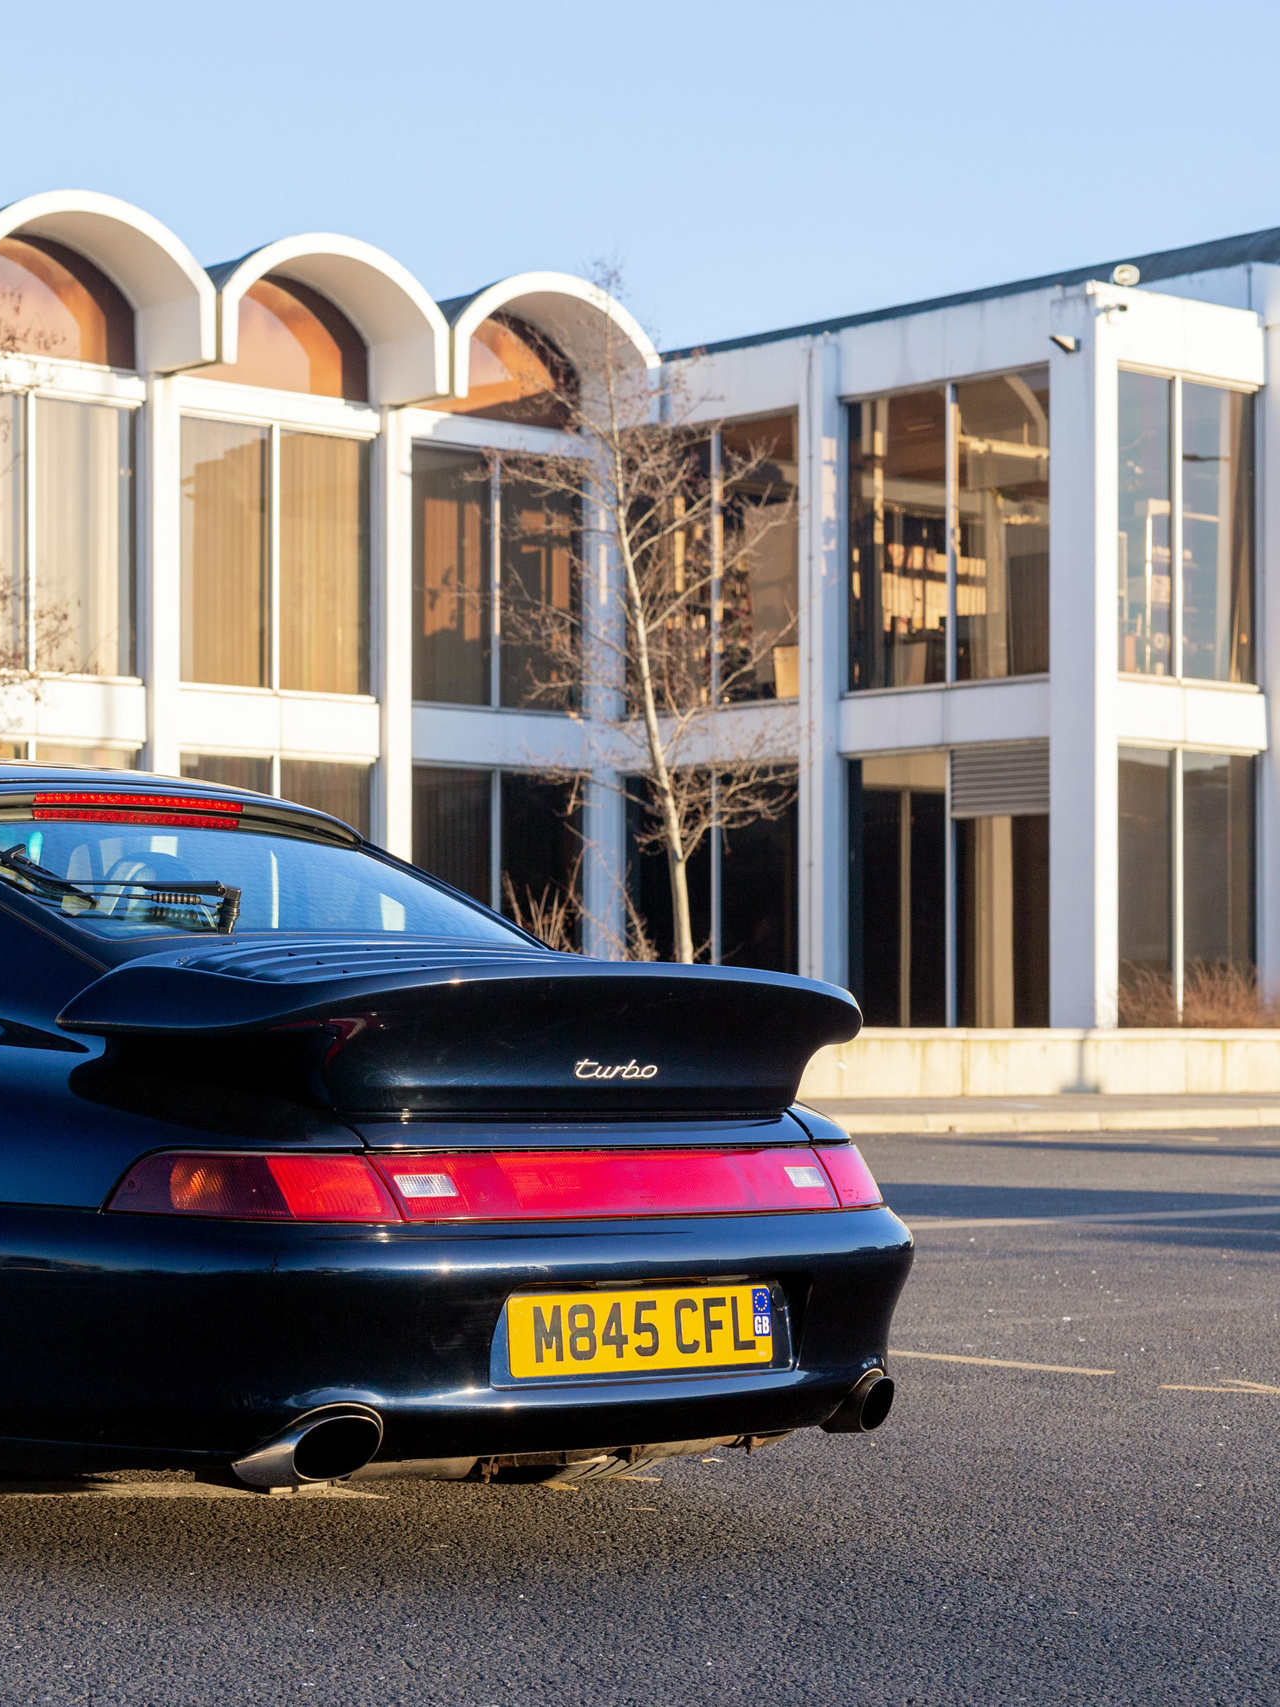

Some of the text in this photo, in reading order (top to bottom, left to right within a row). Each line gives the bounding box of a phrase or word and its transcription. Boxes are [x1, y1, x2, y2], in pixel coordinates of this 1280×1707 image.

[574, 1058, 658, 1079] turbo
[532, 1296, 756, 1363] M845 CFL
[754, 1315, 770, 1335] GB
